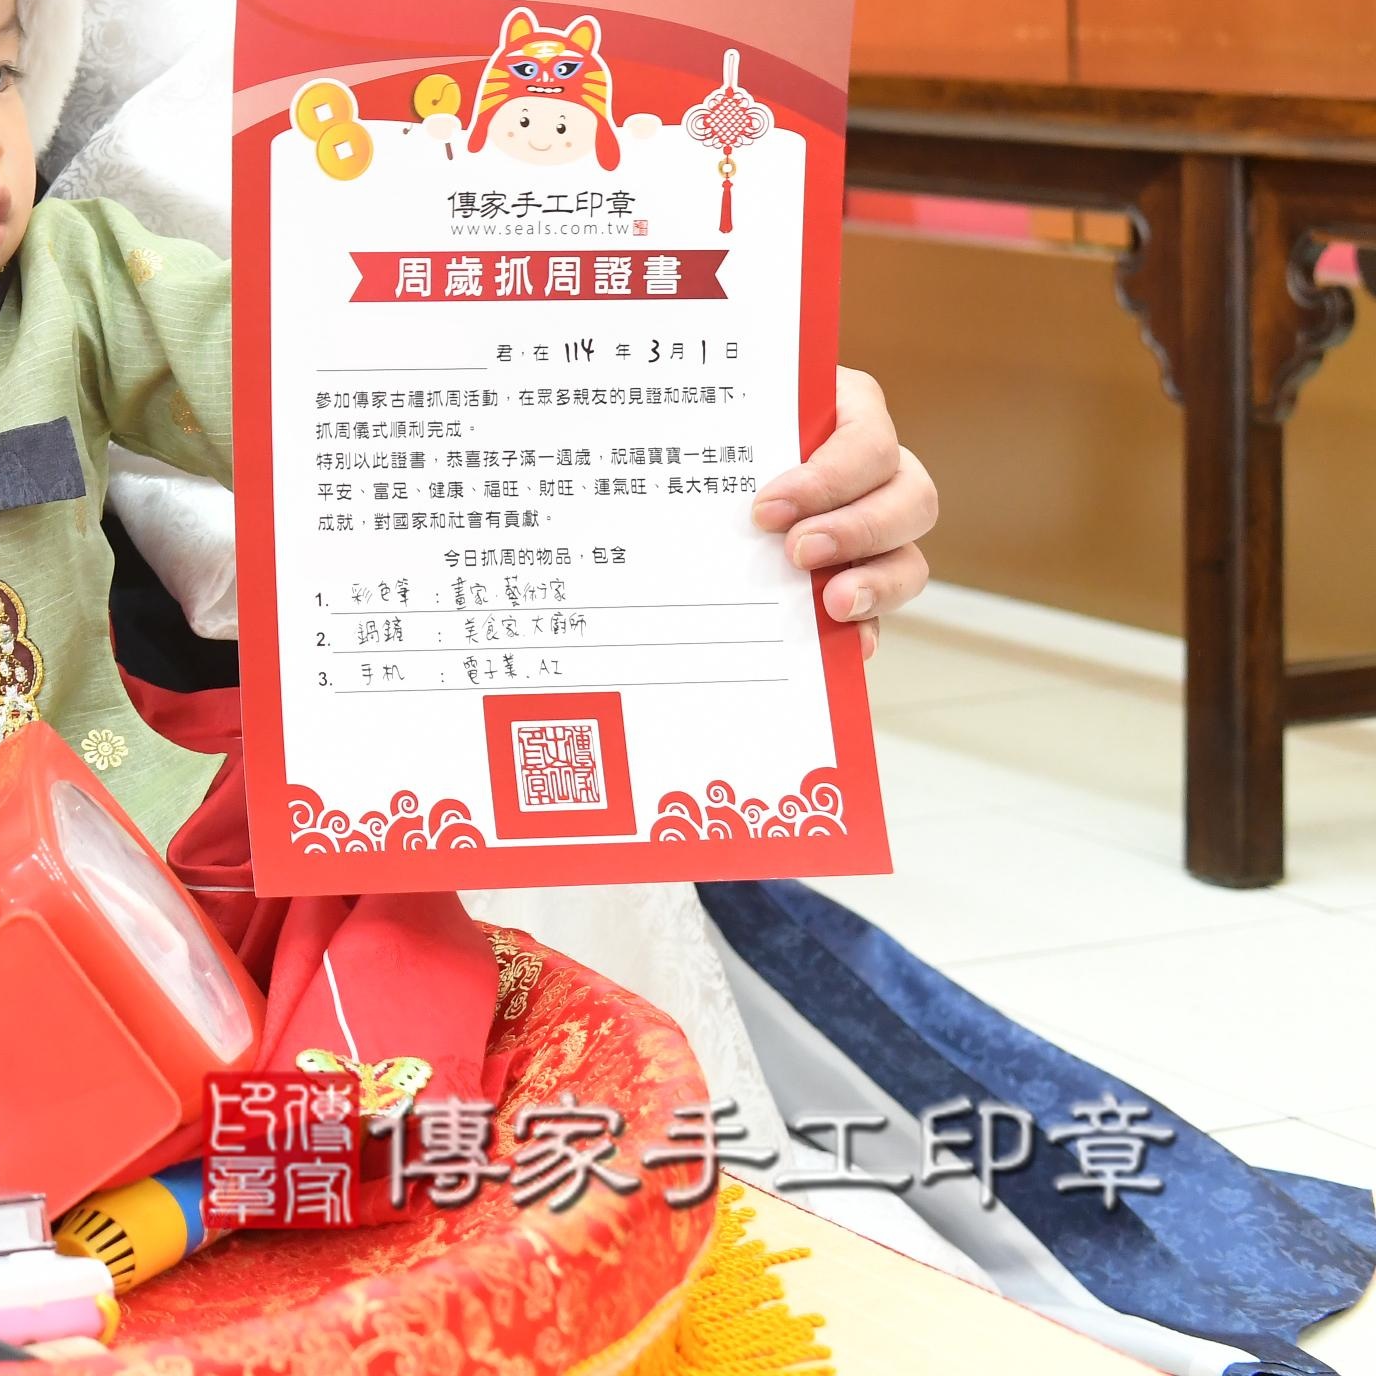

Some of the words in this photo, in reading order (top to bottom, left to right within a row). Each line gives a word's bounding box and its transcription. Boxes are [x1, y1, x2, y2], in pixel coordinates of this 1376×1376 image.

[448, 190, 636, 218] 傳家手工印章
[451, 222, 629, 236] www.seals.com.tw
[395, 255, 682, 298] 周歲抓周證書
[564, 338, 595, 363] 114
[615, 343, 631, 360] 年
[648, 339, 661, 363] 3
[669, 342, 684, 360] 月
[701, 339, 706, 364] 1
[726, 342, 738, 359] 日
[316, 419, 476, 440] 抓周儀式順利完成。
[318, 509, 552, 531] 成就，對國家和社會有貢獻。
[444, 546, 626, 567] 今日抓周的物品，包含
[315, 592, 329, 607] 1.
[352, 578, 409, 607] 彩色筆
[316, 632, 331, 646] 2.
[318, 671, 333, 686] 3.
